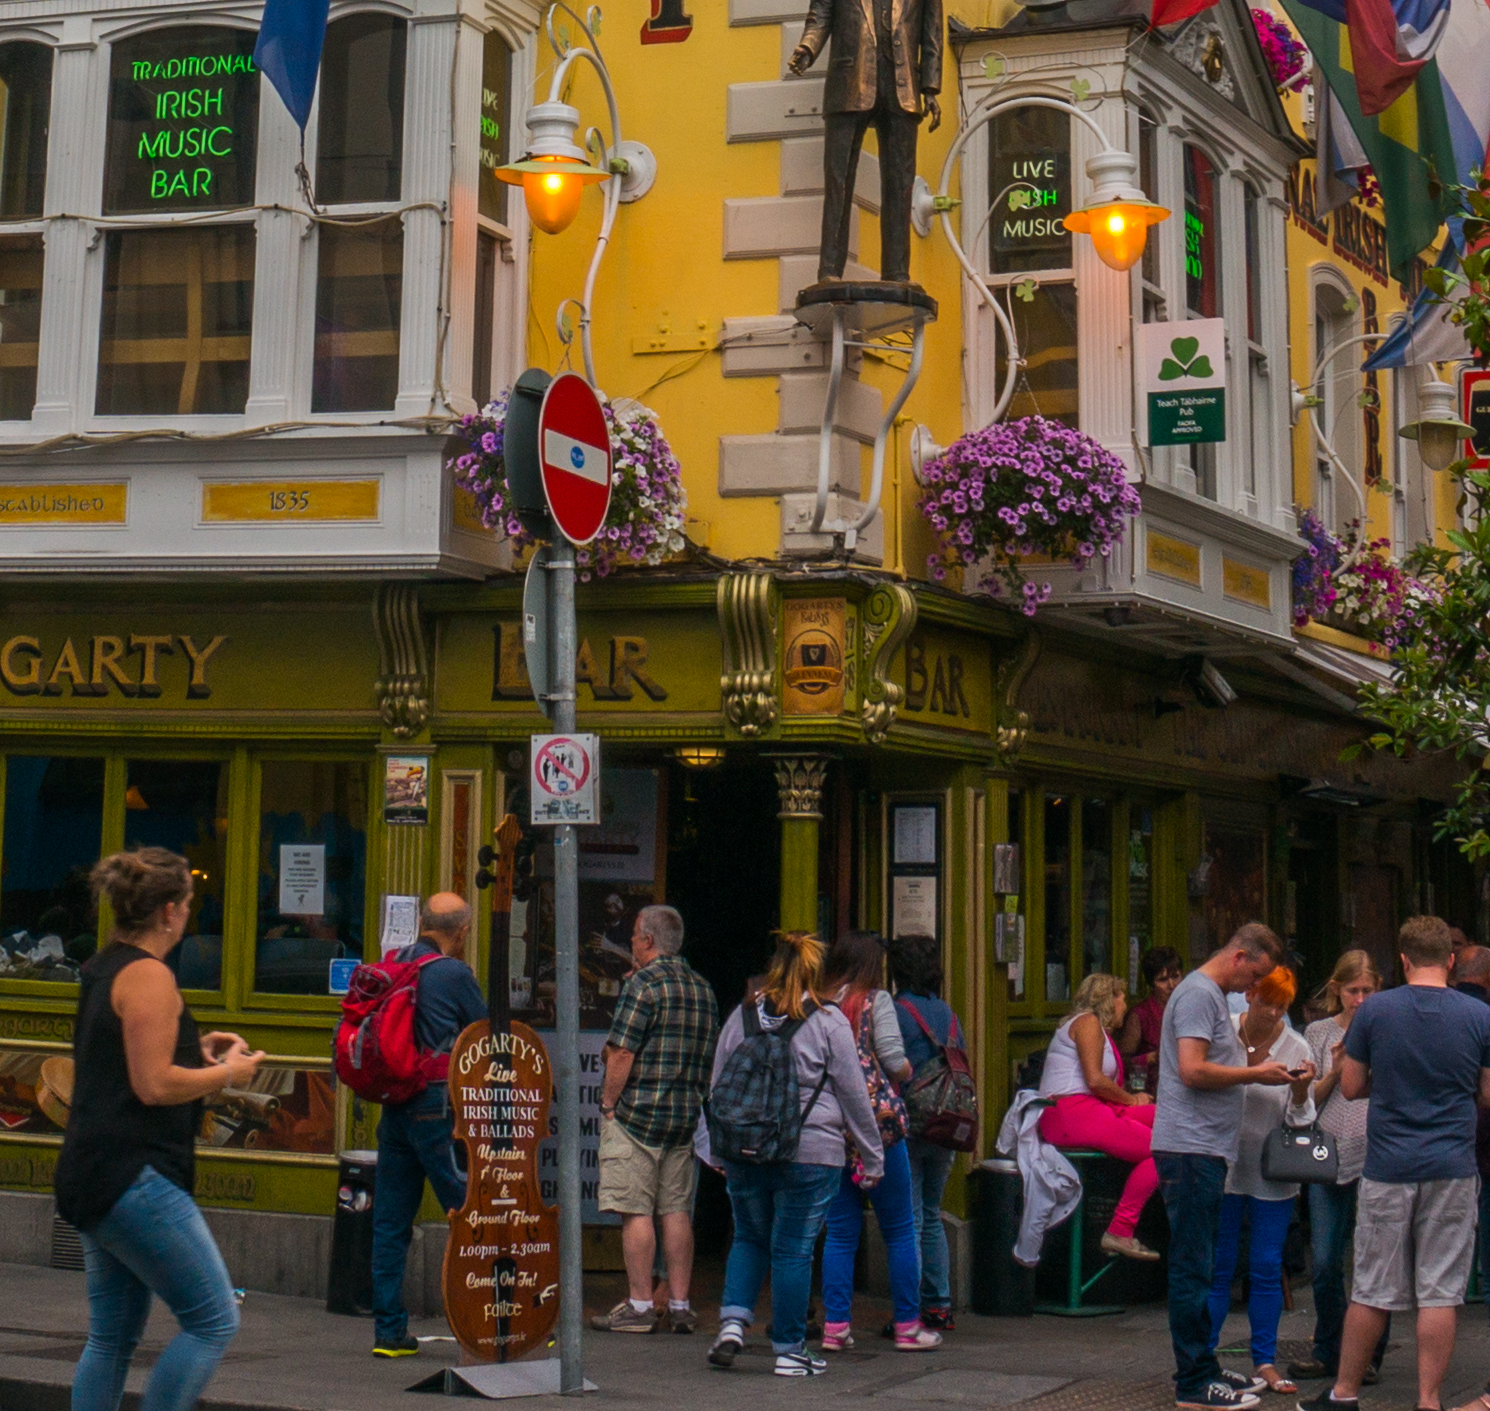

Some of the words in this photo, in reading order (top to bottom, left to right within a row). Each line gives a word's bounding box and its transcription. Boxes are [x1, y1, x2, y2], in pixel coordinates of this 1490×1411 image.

[131, 54, 257, 81] TRADITIONAL
[154, 90, 223, 120] IRISH
[137, 126, 234, 160] MUSIC
[1011, 159, 1055, 180] LIVE
[150, 168, 214, 199] BAR
[1002, 218, 1066, 239] MUSIC
[1156, 398, 1179, 409] Teach
[1179, 408, 1195, 417] Pub
[269, 492, 310, 513] 1835
[904, 634, 974, 721] BAR
[459, 1031, 544, 1075] GOGARTY'S
[483, 1061, 518, 1083] Live
[460, 1086, 544, 1103] TRADITIONAL
[463, 1105, 498, 1120] IRISH
[501, 1106, 540, 1121] MUSIC
[467, 1123, 478, 1138] &
[480, 1123, 535, 1138] BALLADS
[492, 1167, 524, 1184] Floor
[499, 1184, 510, 1198] &
[465, 1210, 508, 1228] Ground
[509, 1210, 540, 1227] Floor
[459, 1244, 499, 1259] 1.00pm
[510, 1242, 551, 1257] 2.30am
[466, 1272, 497, 1289] Come
[499, 1270, 516, 1286] On
[517, 1271, 538, 1287] In!
